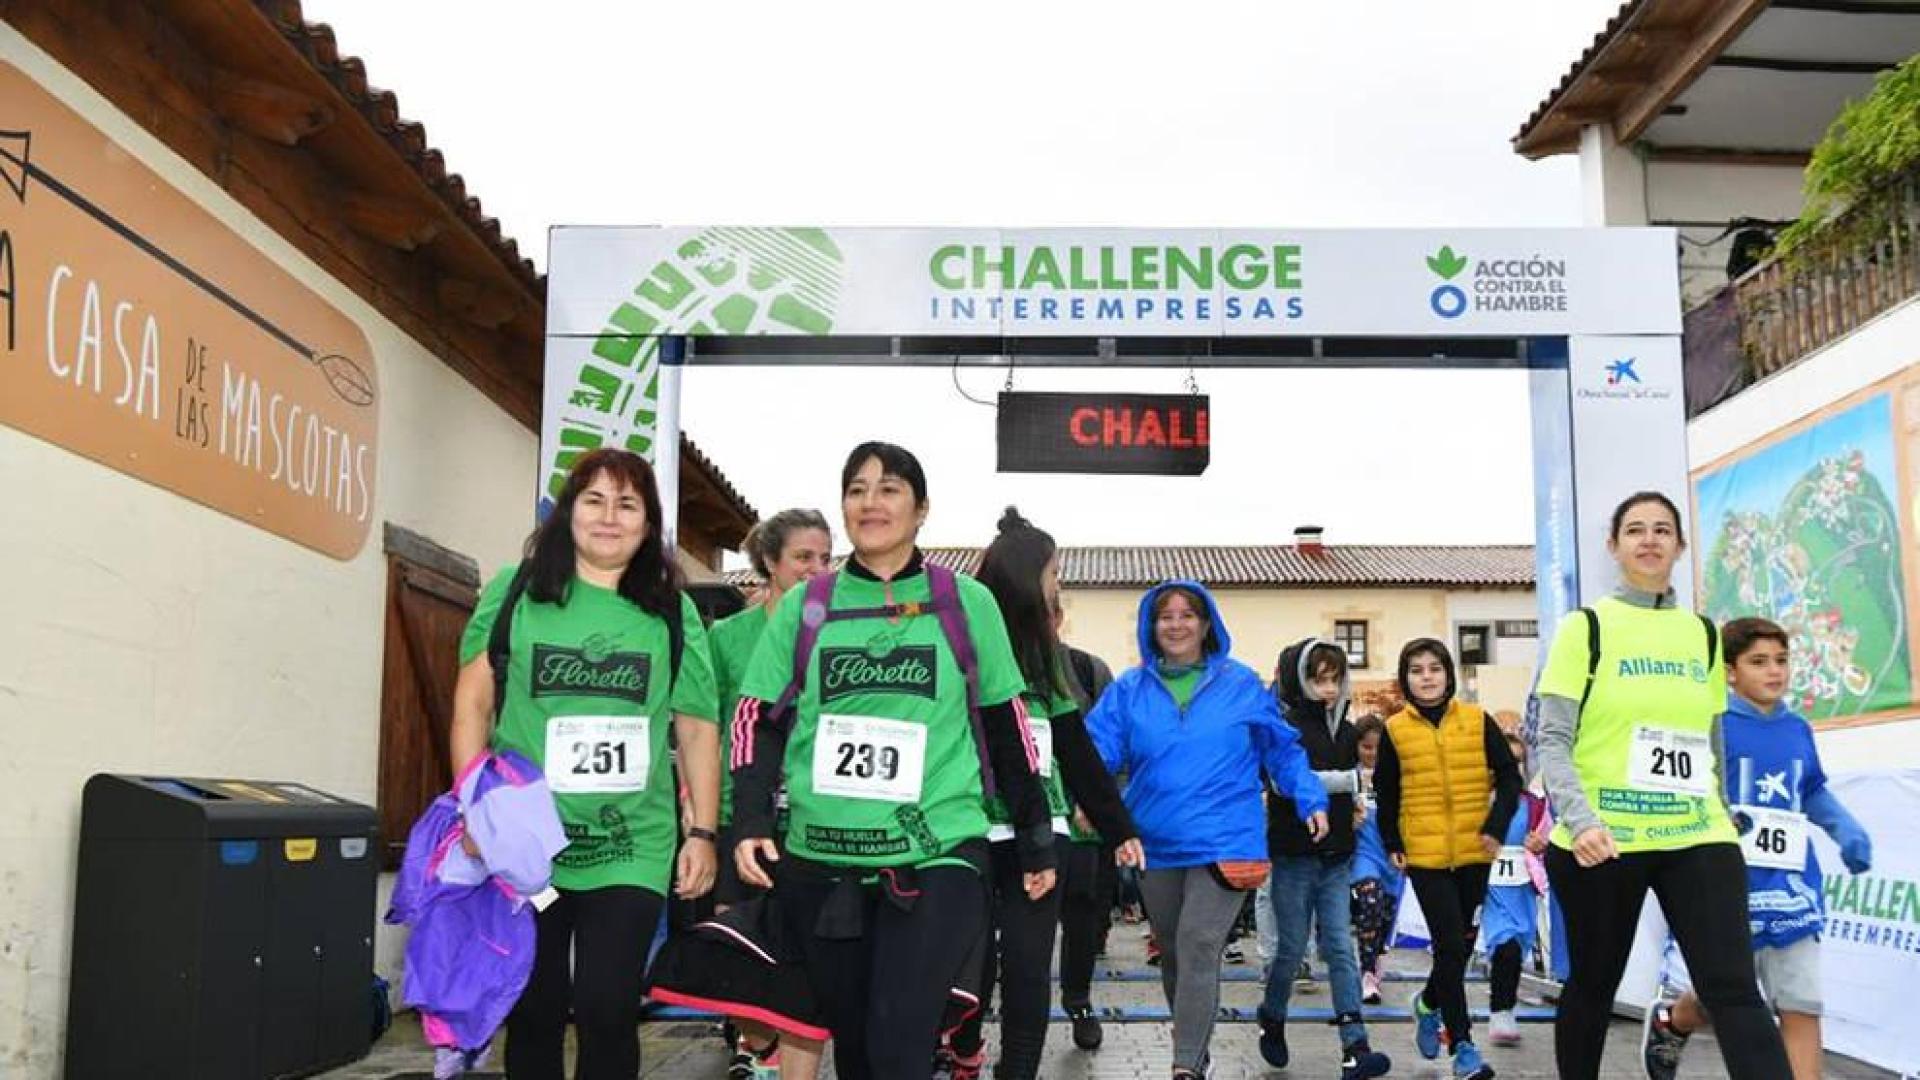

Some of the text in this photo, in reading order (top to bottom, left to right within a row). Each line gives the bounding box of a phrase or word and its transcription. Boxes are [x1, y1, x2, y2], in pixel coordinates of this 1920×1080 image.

[930, 243, 1303, 291] CHALLENGE
[1474, 254, 1566, 278] ACCIÓN
[1474, 280, 1567, 294] CONTRA EL
[1475, 295, 1568, 312] HAMBRE
[930, 296, 1304, 319] INTEREMPRESAS
[47, 264, 161, 420] CASA
[186, 336, 208, 392] DE
[176, 387, 209, 448] LAS
[219, 360, 369, 522] MASCOTAS
[539, 653, 645, 690] Florette
[826, 653, 932, 689] Florette
[1618, 657, 1685, 677] Allianz
[572, 741, 627, 775] 251
[835, 742, 900, 781] 239
[1651, 747, 1692, 780] 210
[1755, 827, 1787, 854] 46
[1497, 858, 1514, 877] 71
[1824, 872, 1920, 923] HALLEN
